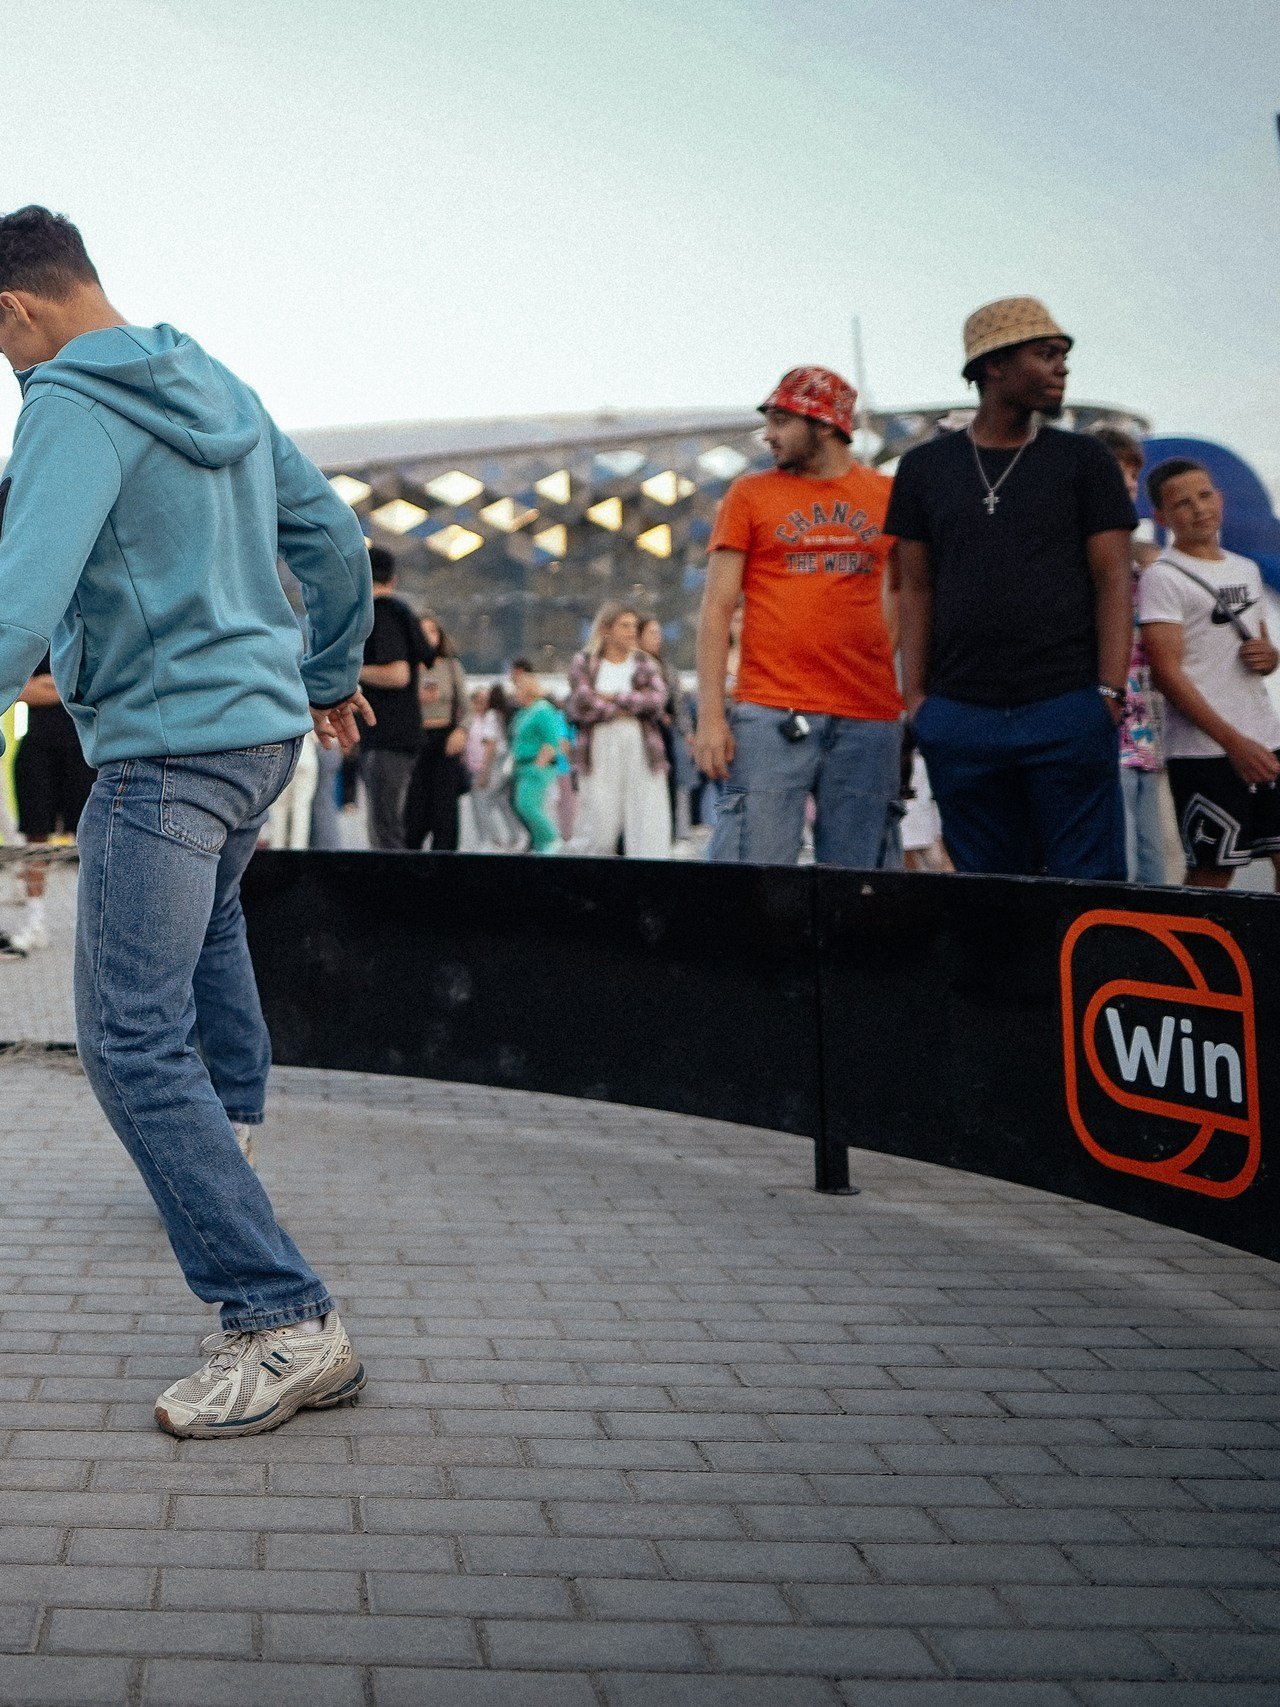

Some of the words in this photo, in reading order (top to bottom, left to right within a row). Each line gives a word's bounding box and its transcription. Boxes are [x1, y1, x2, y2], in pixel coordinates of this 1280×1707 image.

[775, 499, 881, 544] CHANGE
[785, 552, 818, 572] THE
[1105, 1006, 1243, 1104] Win
